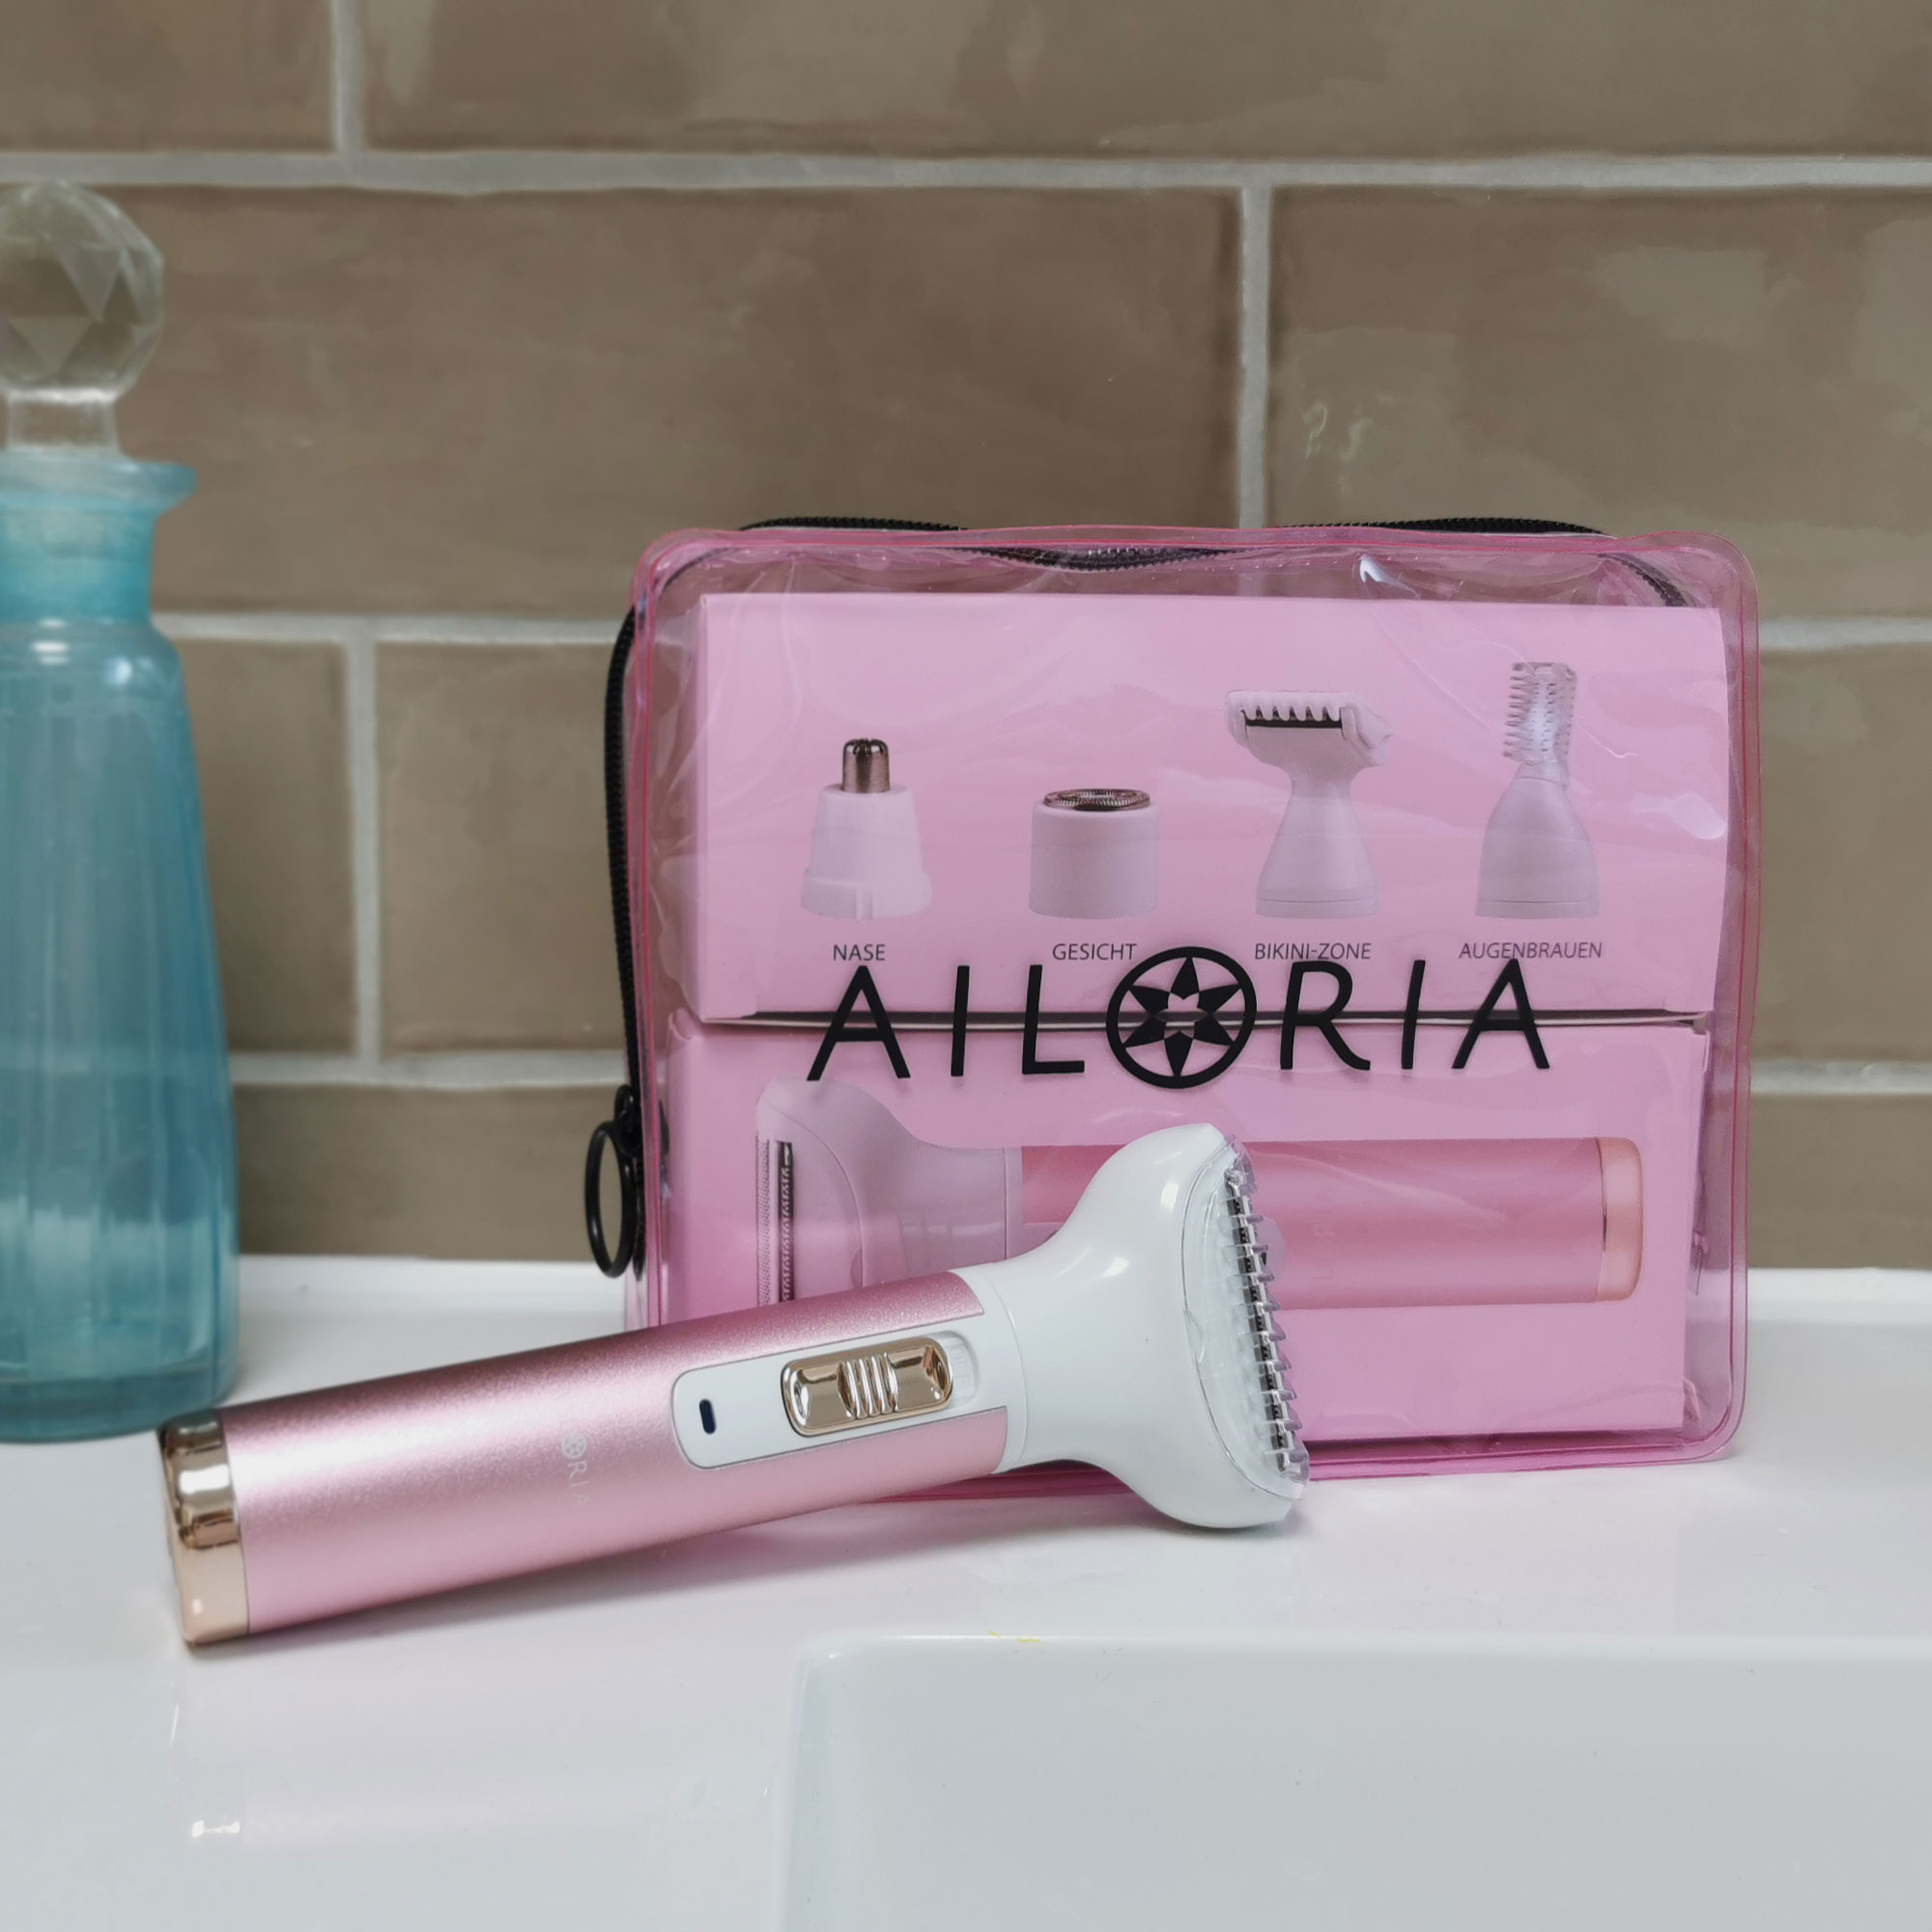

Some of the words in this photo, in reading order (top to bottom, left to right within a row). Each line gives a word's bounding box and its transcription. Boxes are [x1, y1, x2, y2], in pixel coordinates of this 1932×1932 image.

[833, 944, 886, 961] NASE
[1052, 943, 1137, 961] GESICHT
[1254, 942, 1372, 960] BIKINI-ZONE
[1458, 942, 1603, 959] AUGENBRAUEN
[806, 946, 1550, 1090] AILORIA
